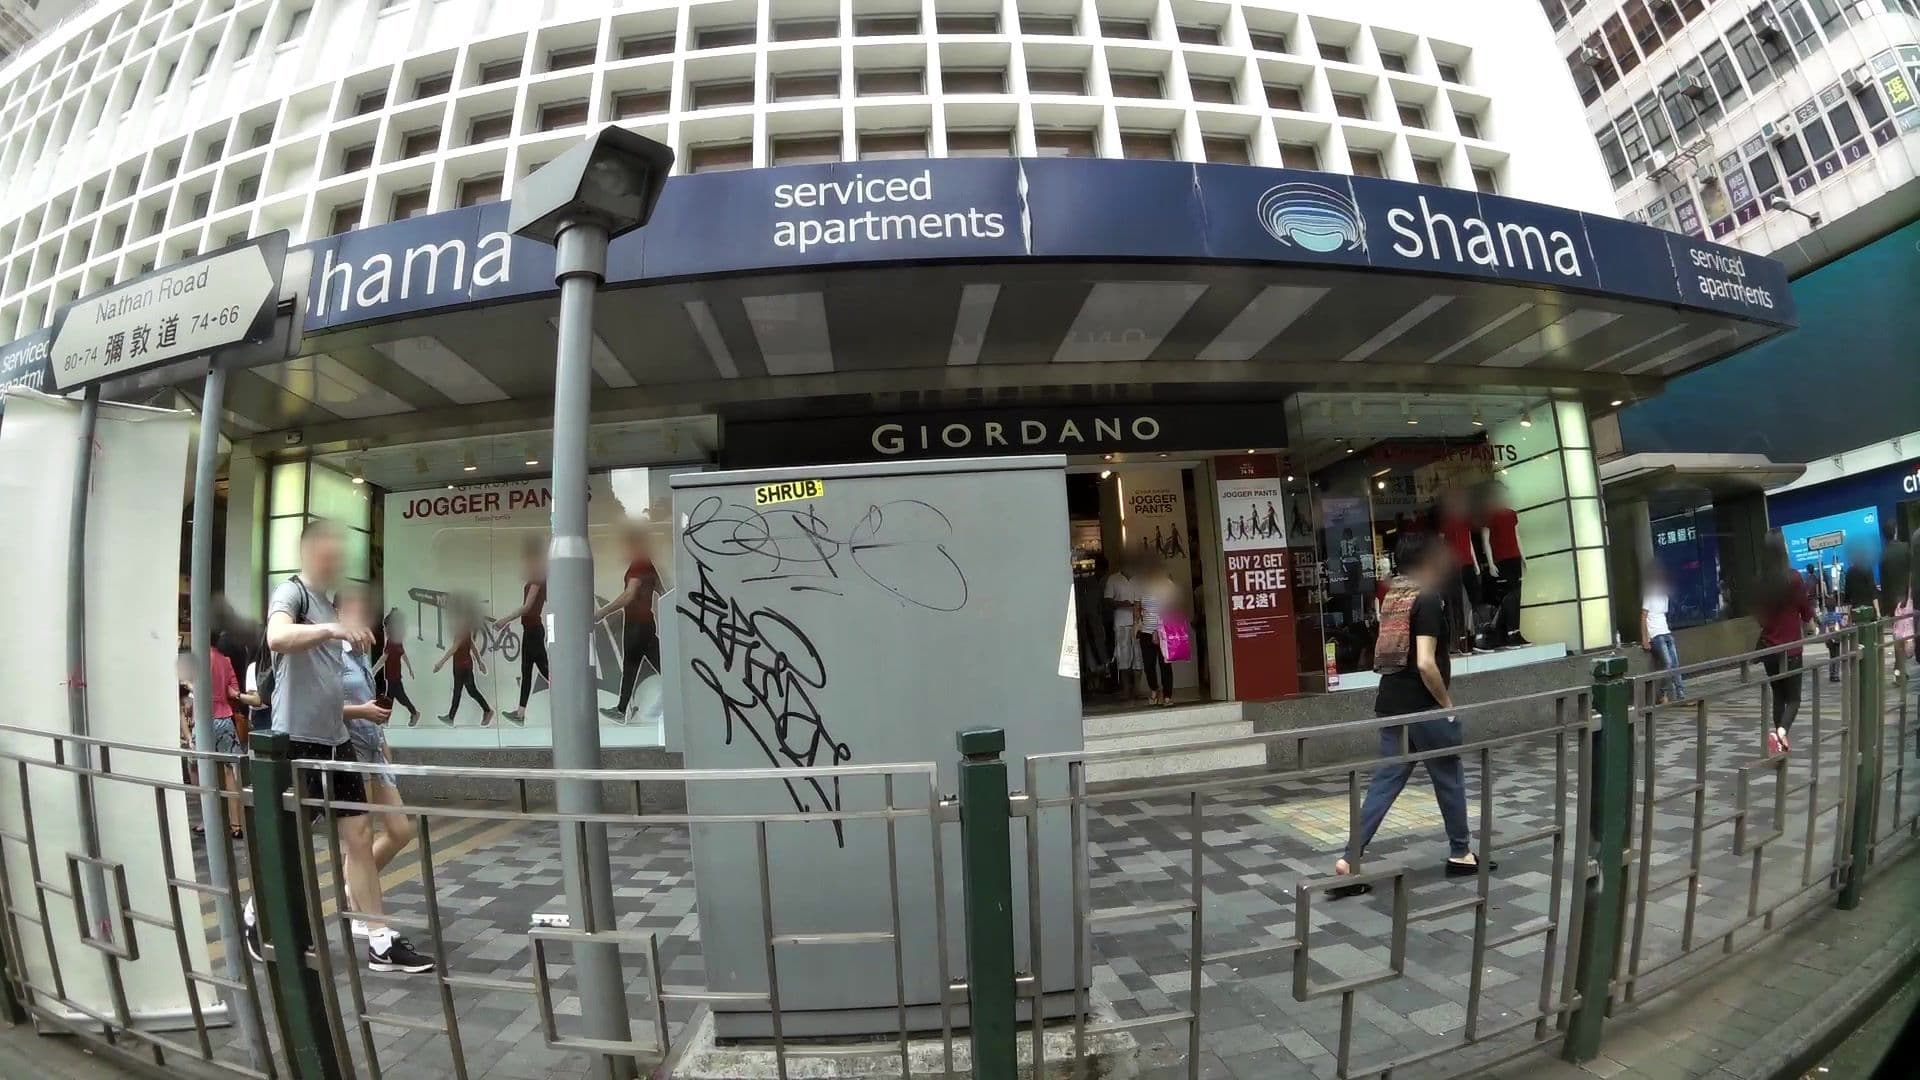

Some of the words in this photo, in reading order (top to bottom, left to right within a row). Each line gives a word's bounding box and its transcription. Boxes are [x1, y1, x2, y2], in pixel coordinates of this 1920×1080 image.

[1825, 161, 1834, 175] 9
[774, 169, 933, 209] serviced
[773, 207, 1006, 254] apartments
[1386, 195, 1582, 278] shama
[306, 231, 513, 317] hama
[1689, 248, 1746, 278] serviced
[95, 288, 153, 325] Nathan
[158, 265, 210, 303] Road
[1697, 275, 1774, 309] apartments
[104, 313, 180, 367] 彌敦道
[871, 416, 1161, 455] GIORDANO
[403, 494, 500, 520] JOGGER
[757, 480, 818, 504] SHRUB
[1128, 494, 1177, 505] JOGGER
[1222, 490, 1253, 498] JOGGER
[1254, 489, 1278, 497] PANTS
[1134, 504, 1173, 514] PANTS
[1228, 556, 1251, 571] BUY
[1253, 555, 1261, 569] 2
[1263, 553, 1284, 568] GET
[1230, 572, 1239, 593] 1
[1244, 568, 1287, 592] FREE
